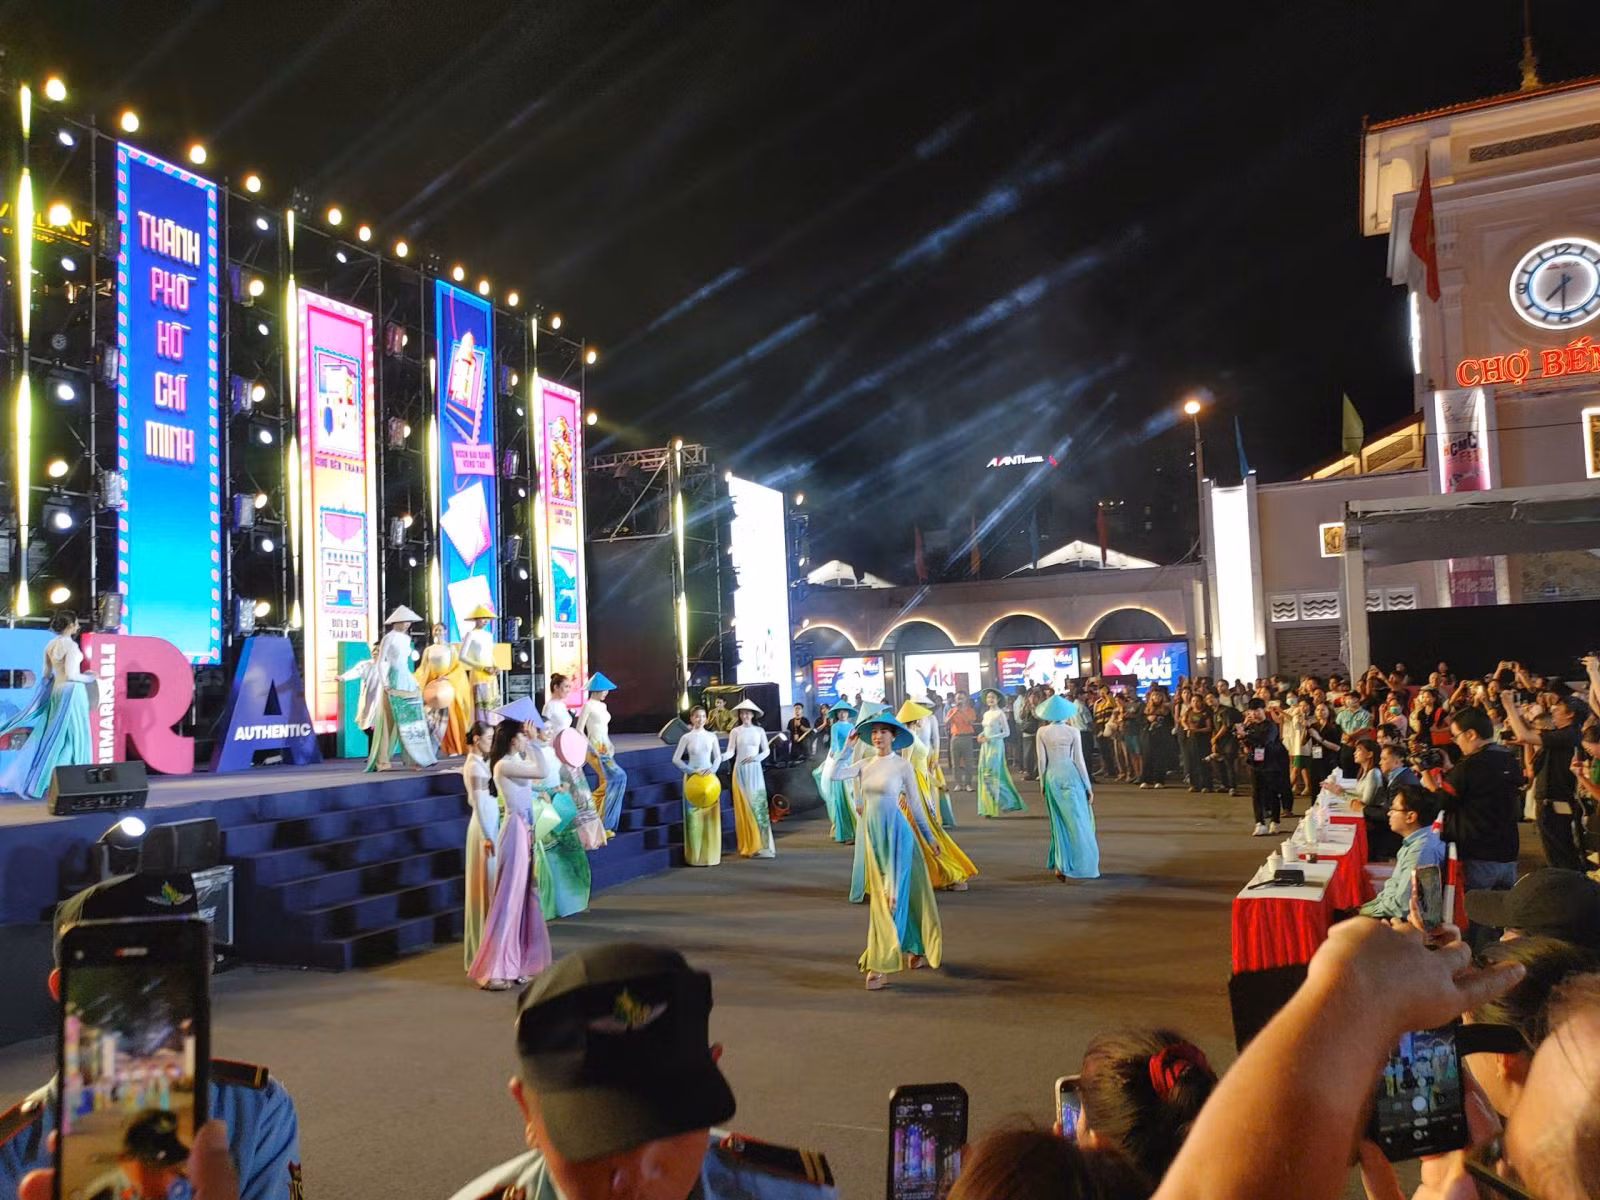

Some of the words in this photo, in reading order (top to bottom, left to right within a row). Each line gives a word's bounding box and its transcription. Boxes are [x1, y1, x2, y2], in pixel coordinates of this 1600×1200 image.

[1552, 243, 1572, 256] 12
[1456, 348, 1530, 387] CHỢ
[145, 420, 195, 464] MINH
[1112, 647, 1172, 680] Vikki
[234, 723, 311, 741] AUTHENTIC
